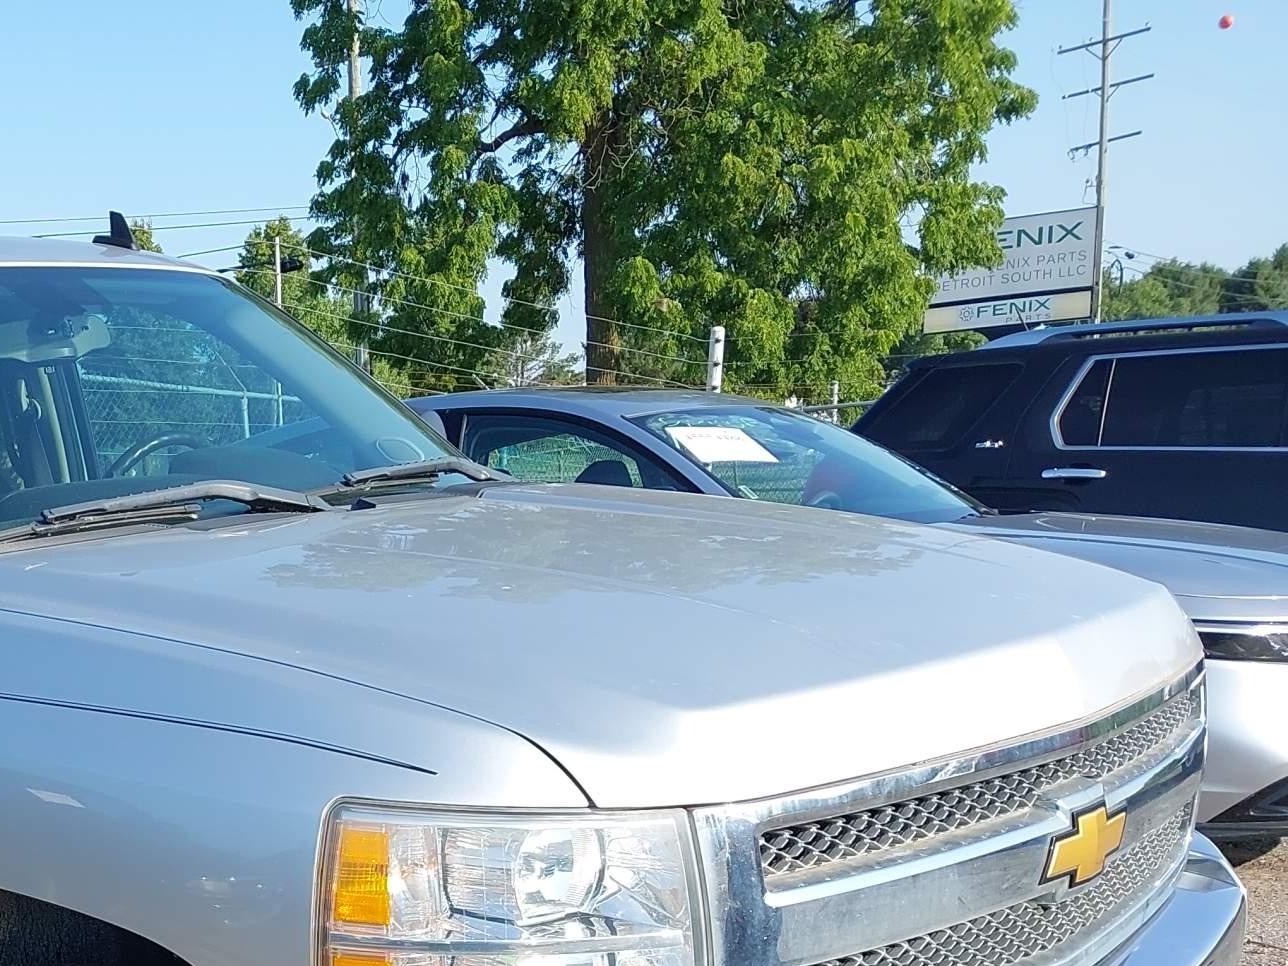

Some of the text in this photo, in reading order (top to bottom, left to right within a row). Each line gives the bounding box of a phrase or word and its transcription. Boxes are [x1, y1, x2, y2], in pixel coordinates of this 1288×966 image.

[997, 221, 1084, 250] ENIX
[1036, 250, 1087, 266] PARTS
[1001, 269, 1052, 285] SOUTH
[1058, 264, 1087, 278] LLC
[976, 298, 1051, 318] FENIX
